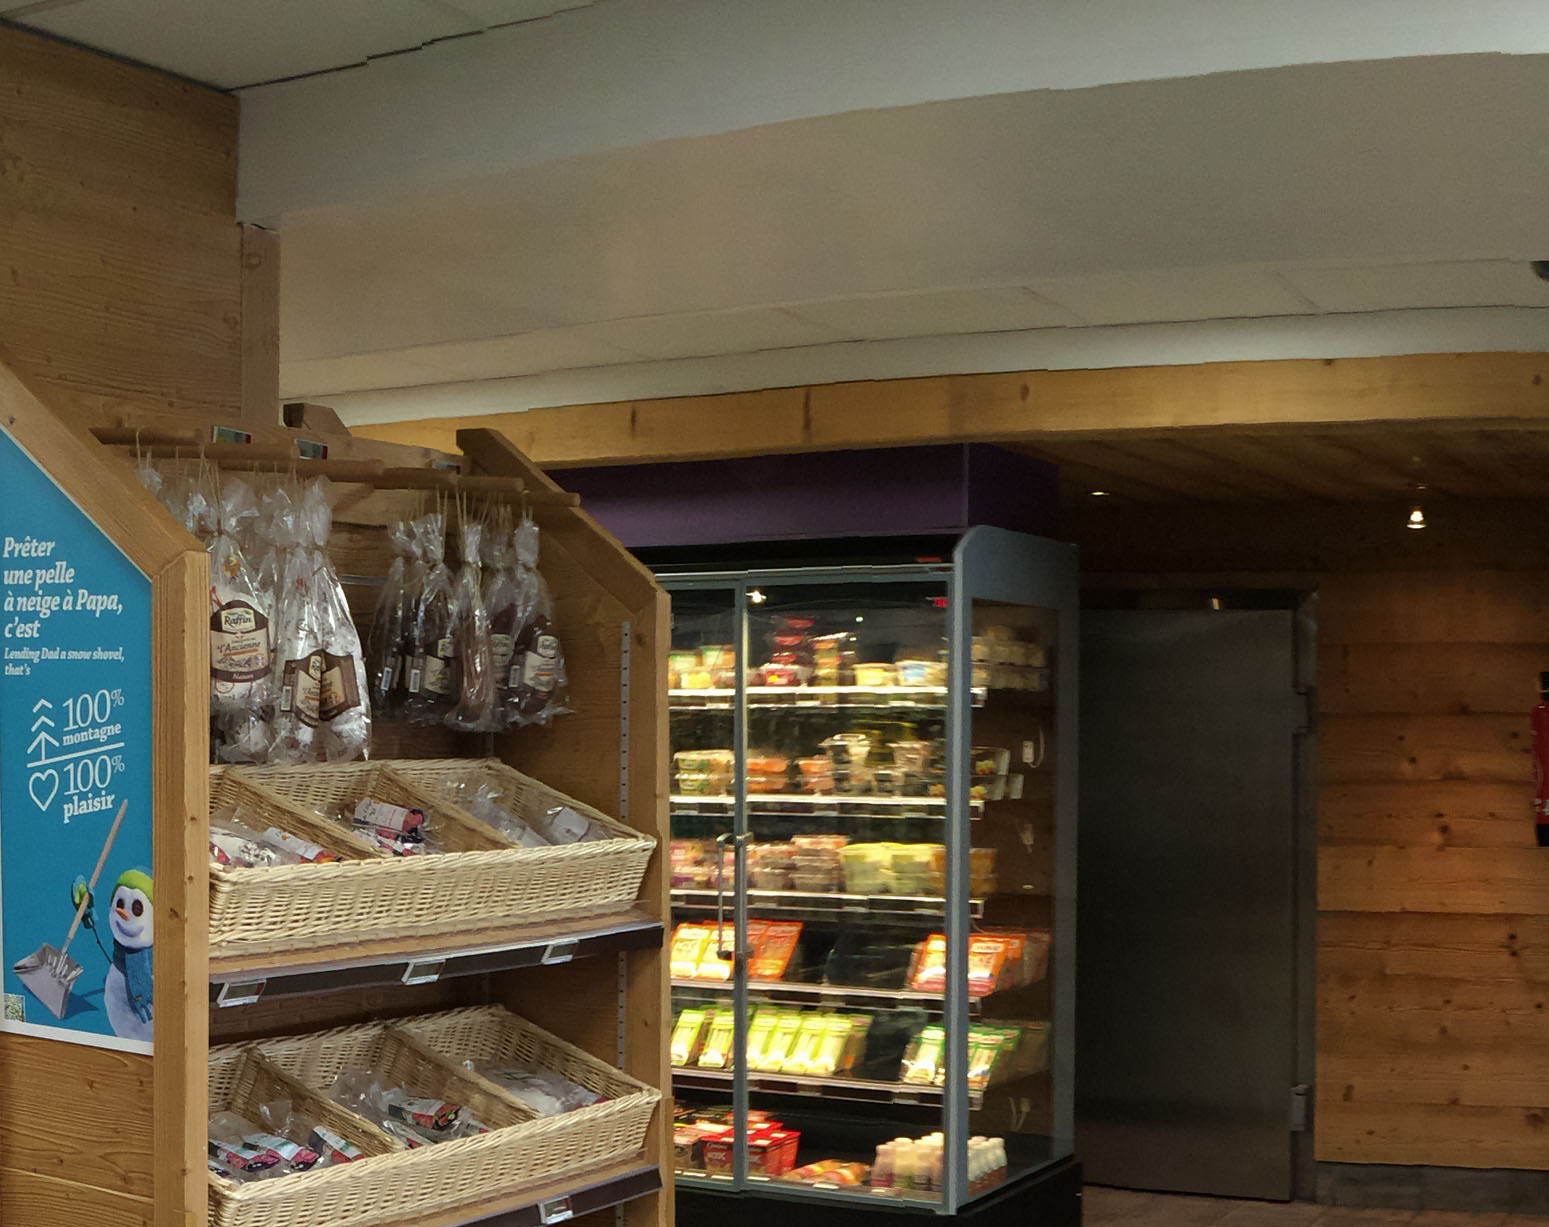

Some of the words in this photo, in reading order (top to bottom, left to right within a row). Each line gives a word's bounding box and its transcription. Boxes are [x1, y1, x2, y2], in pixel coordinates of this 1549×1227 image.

[2, 536, 55, 558] Prêter
[4, 569, 33, 584] une
[35, 561, 75, 591] pelle
[4, 591, 14, 611] à
[17, 590, 60, 618] neige
[63, 589, 74, 610] à
[76, 589, 123, 617] Papa,
[4, 617, 41, 638] c'est
[4, 647, 40, 664] Lending
[41, 647, 60, 660] Dad
[60, 652, 66, 660] a
[67, 651, 91, 660] snow
[92, 647, 125, 662] shovel,
[4, 663, 31, 675] that's
[62, 689, 125, 731] 100%
[62, 723, 122, 746] montagne
[63, 755, 125, 796] 100%
[63, 790, 115, 823] plaisir
